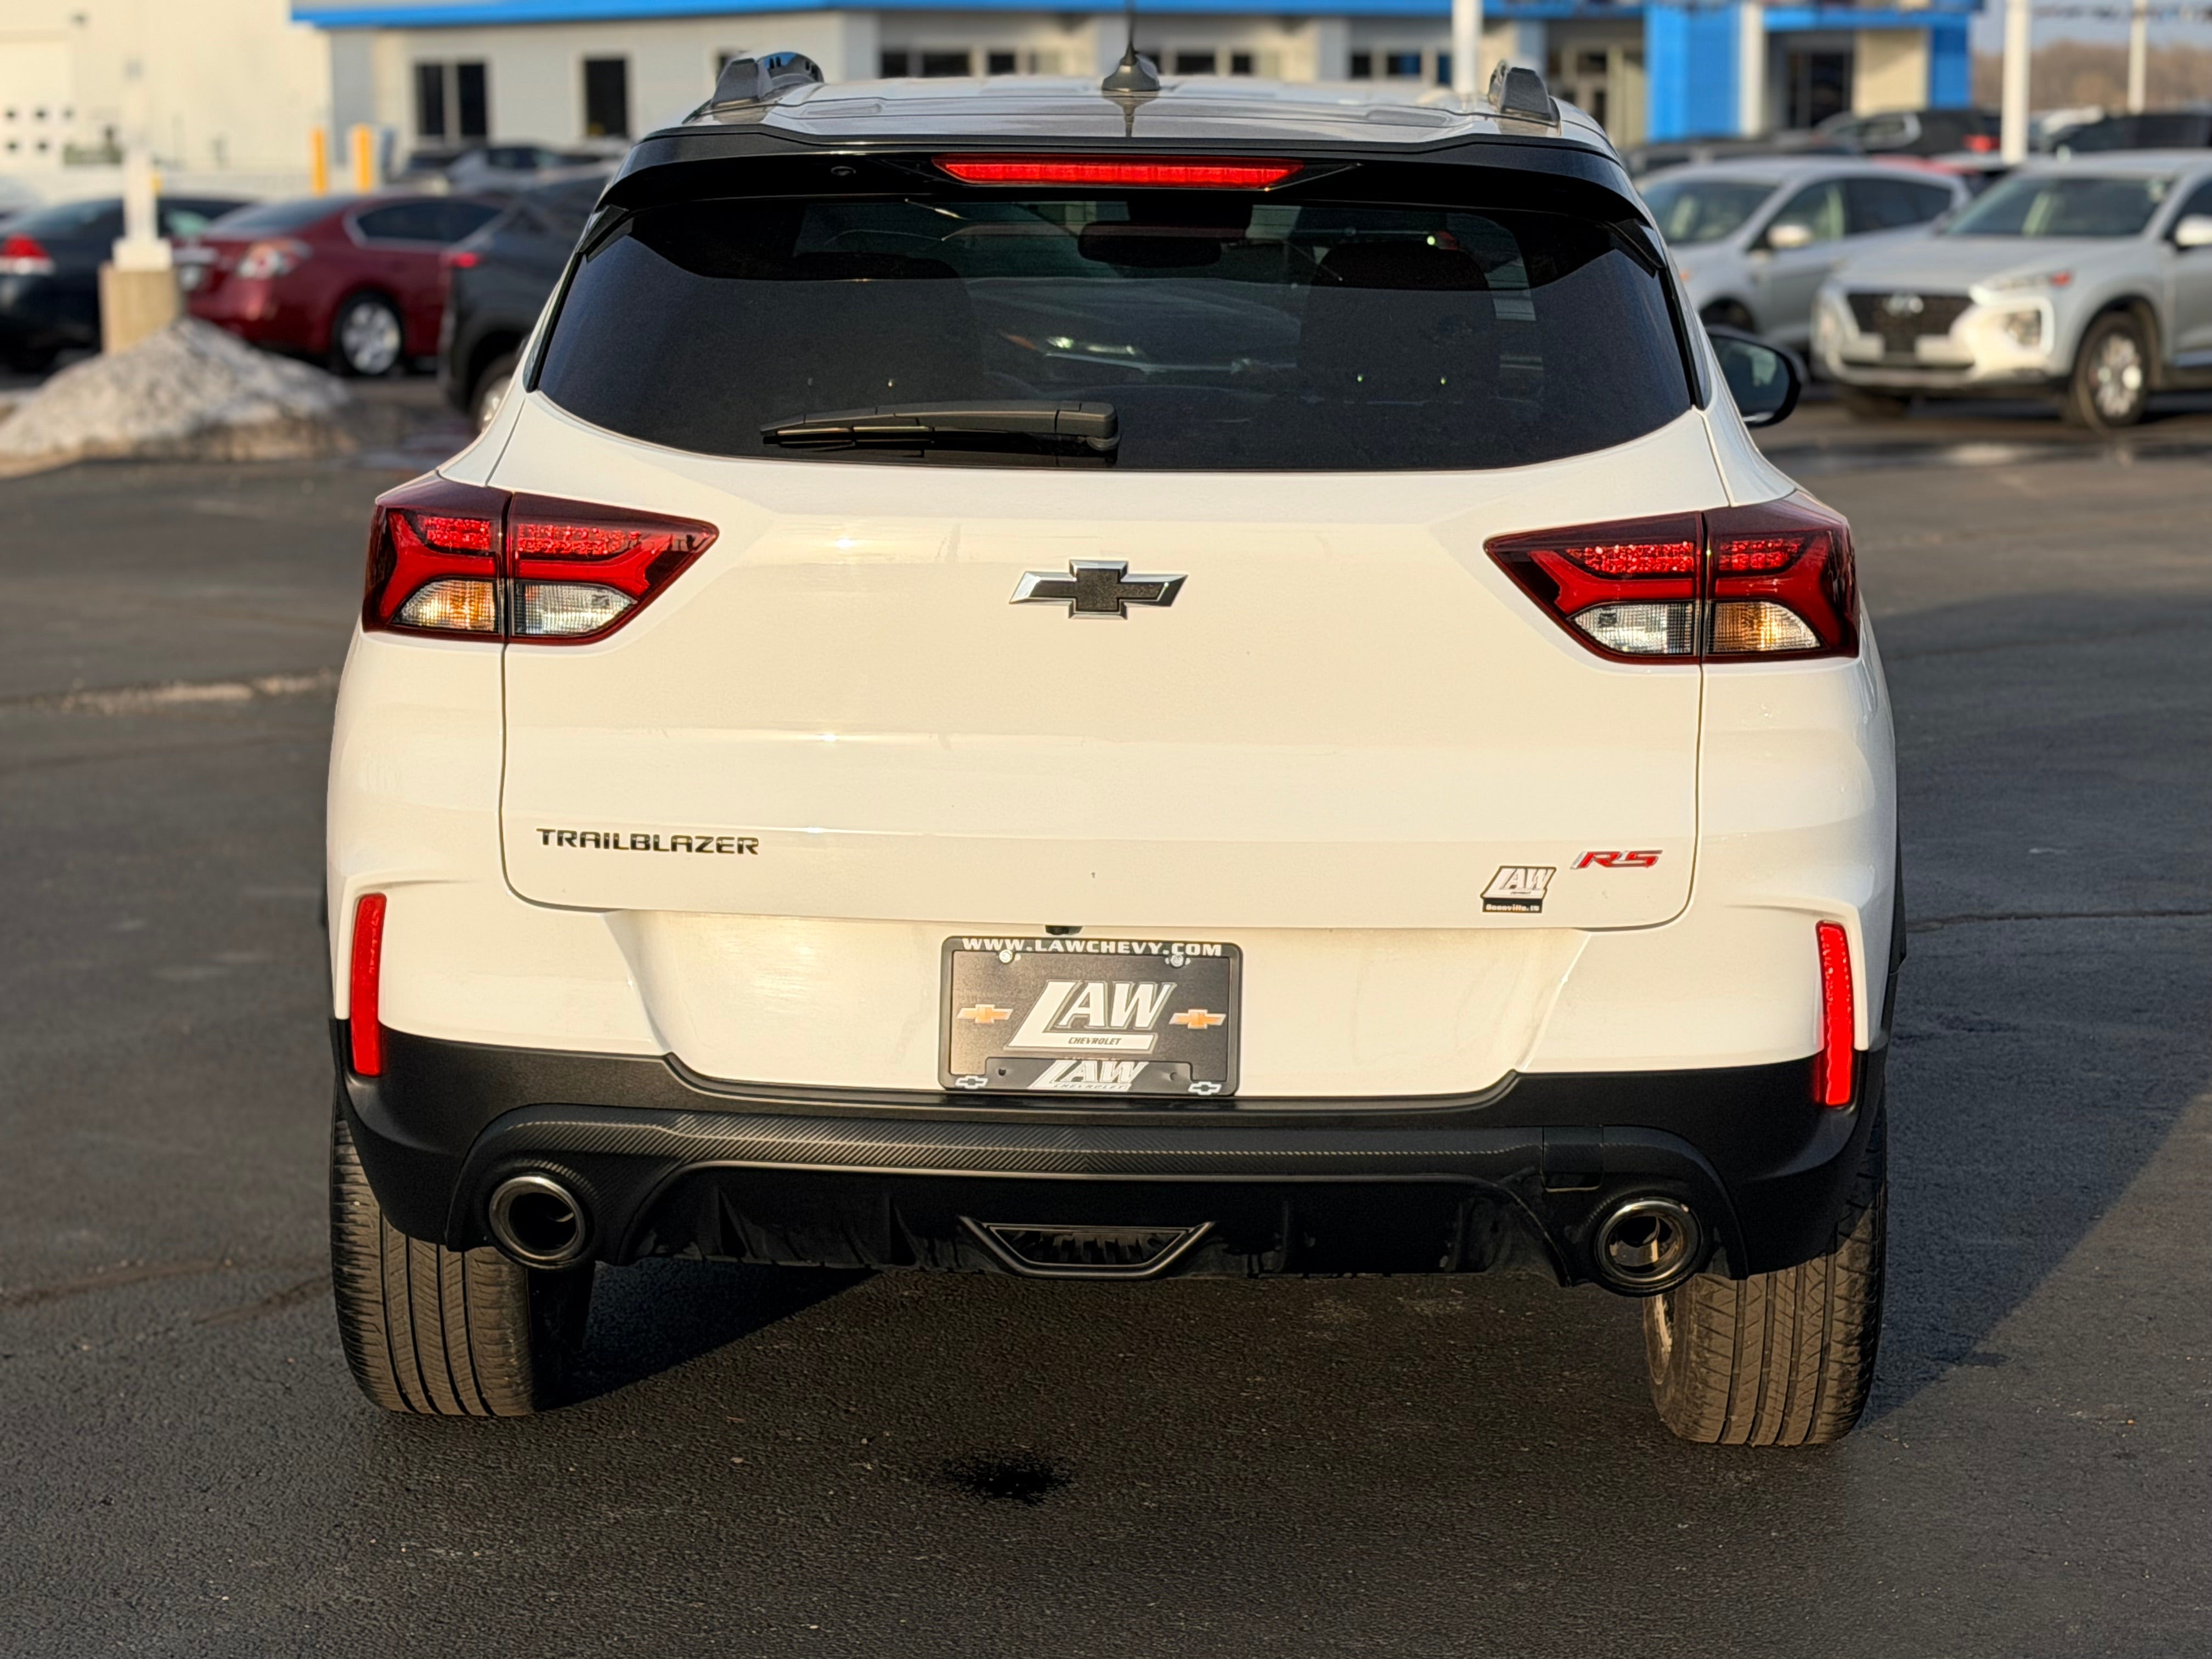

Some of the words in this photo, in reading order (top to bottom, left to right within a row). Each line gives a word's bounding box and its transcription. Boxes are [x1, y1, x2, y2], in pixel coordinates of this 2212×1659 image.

[536, 828, 759, 855] TRAILBLAZER
[1570, 850, 1663, 869] RS
[1481, 867, 1555, 898] LAW
[962, 938, 1222, 956] WWW.LAWCHEVY.COM
[1005, 980, 1177, 1051] LAW
[1068, 1036, 1122, 1045] CHEVROLET
[1027, 1059, 1149, 1091] LAW
